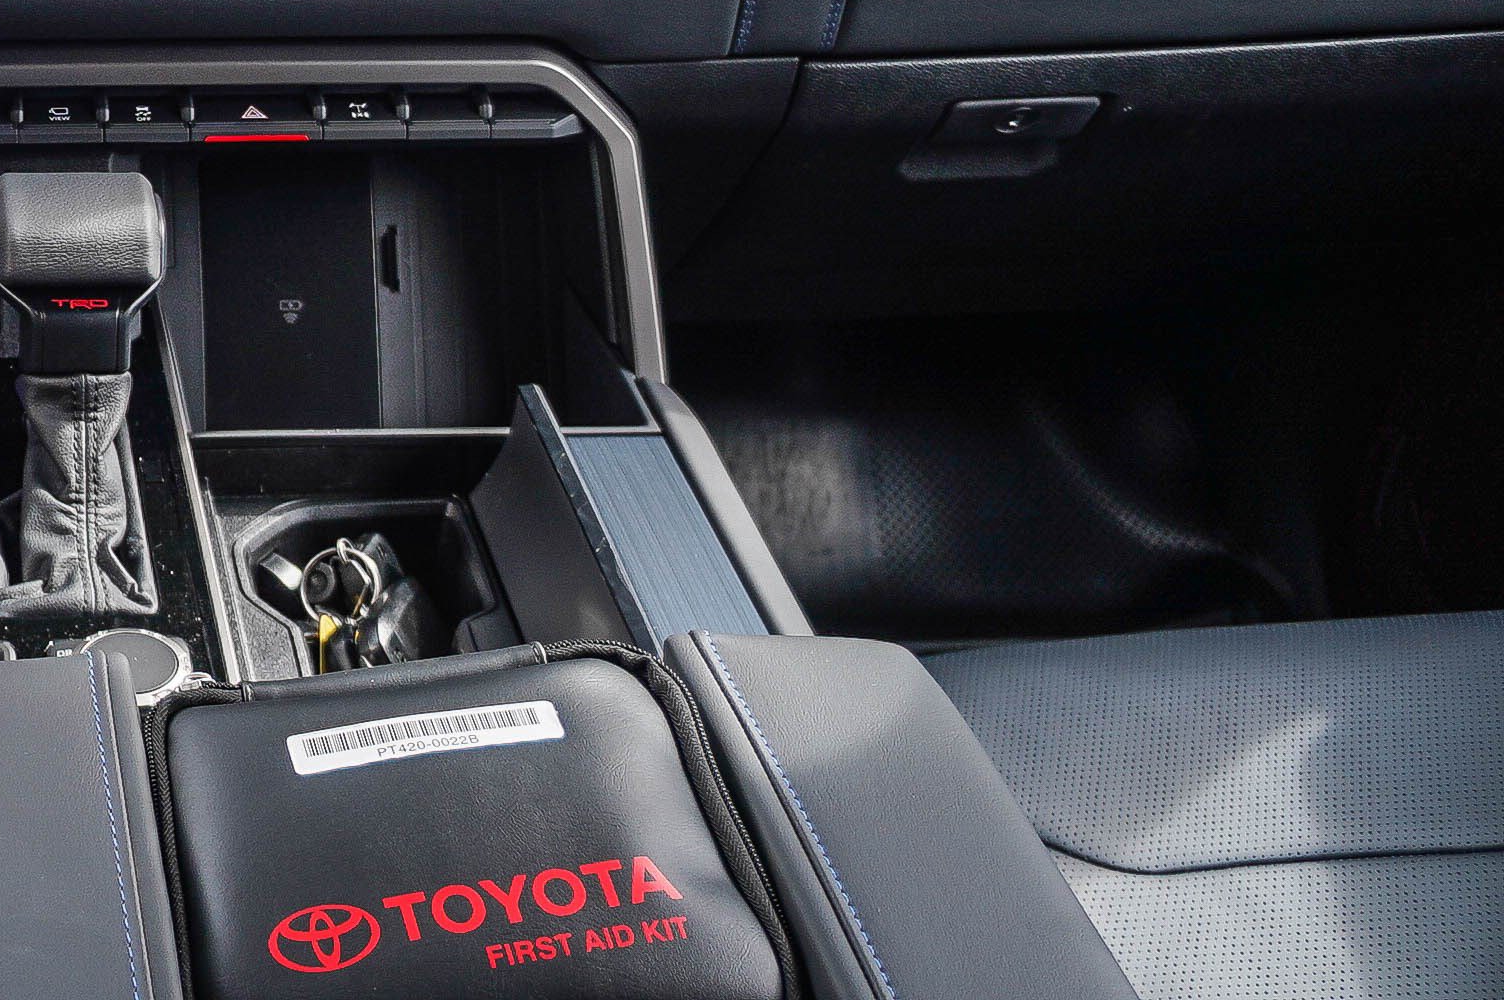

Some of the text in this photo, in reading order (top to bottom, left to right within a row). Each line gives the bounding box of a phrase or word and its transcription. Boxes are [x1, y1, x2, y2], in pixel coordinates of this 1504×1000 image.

[51, 298, 109, 309] TRD
[377, 733, 479, 758] PT420-0022B
[382, 856, 684, 943] TOYOTA
[485, 915, 690, 969] FIRST AID KIT
